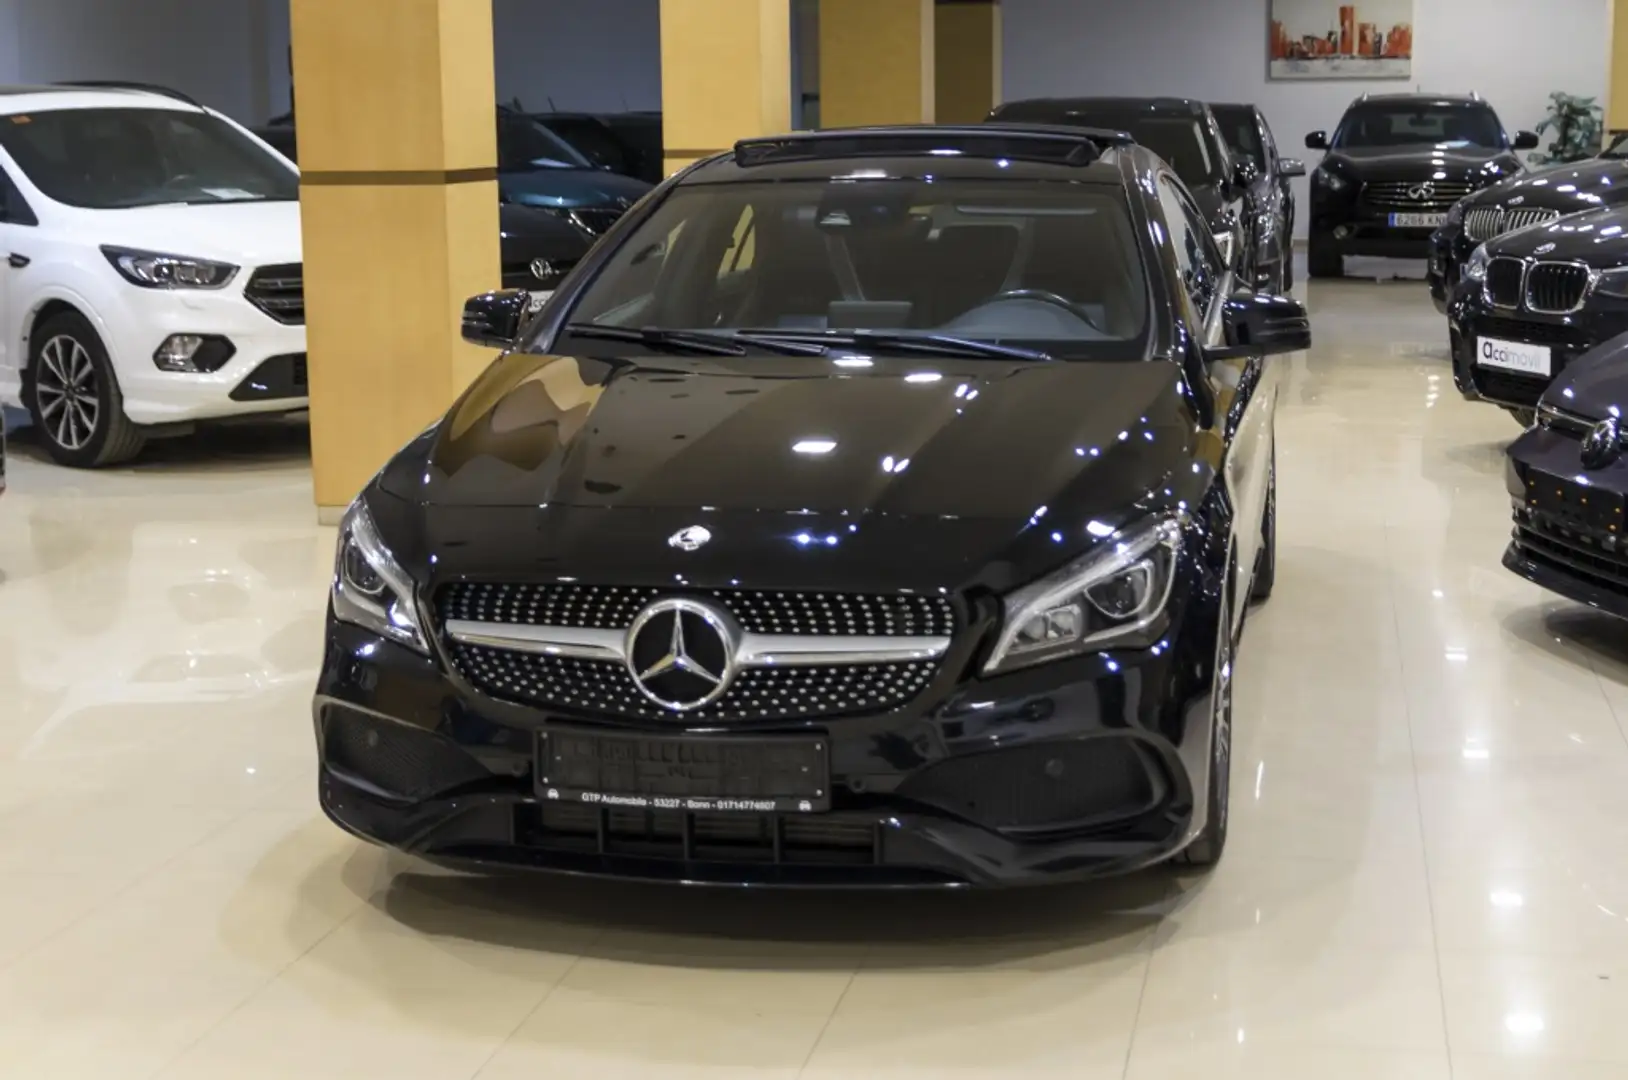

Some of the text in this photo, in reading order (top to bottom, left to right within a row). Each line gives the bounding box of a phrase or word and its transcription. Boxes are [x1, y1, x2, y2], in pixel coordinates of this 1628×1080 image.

[581, 792, 600, 802] GTP
[601, 794, 647, 806] Automobile
[687, 799, 710, 809] Bonn
